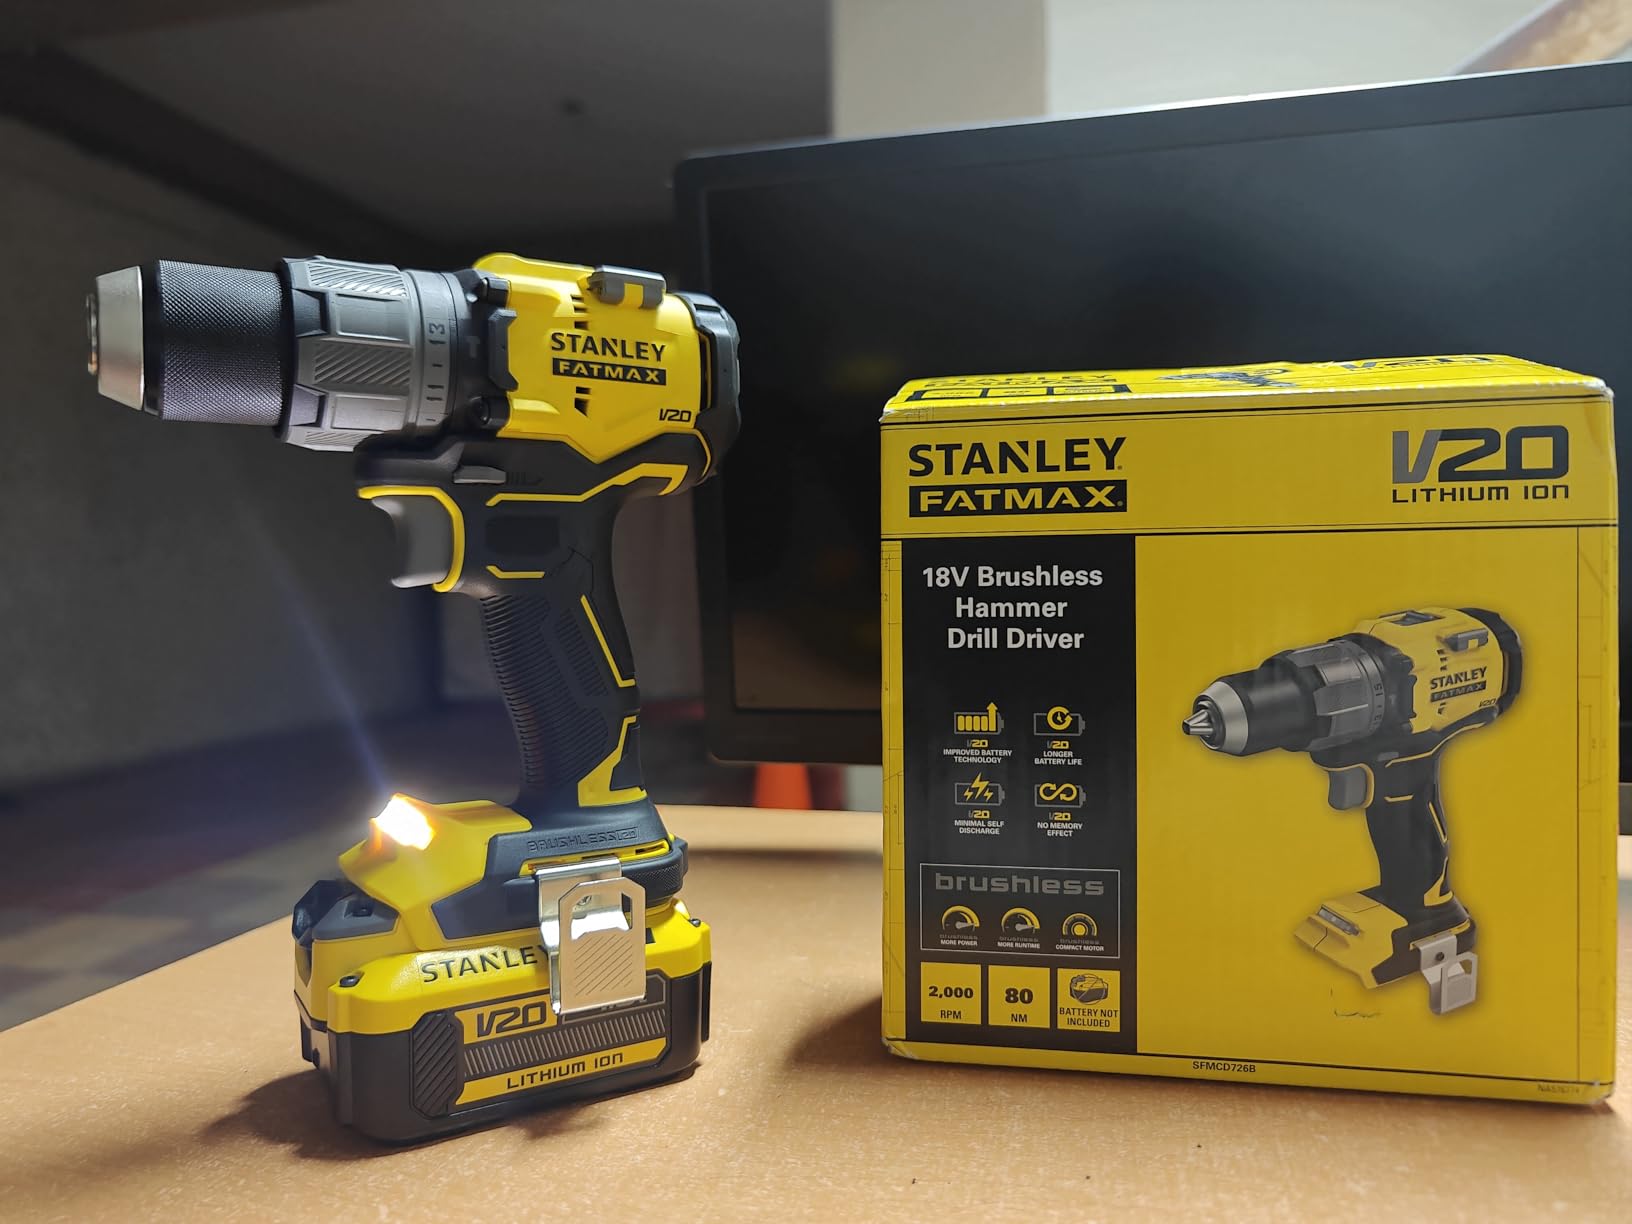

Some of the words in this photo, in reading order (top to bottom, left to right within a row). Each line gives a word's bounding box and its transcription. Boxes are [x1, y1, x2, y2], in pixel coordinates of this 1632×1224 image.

[551, 332, 666, 362] STANLEY
[558, 360, 660, 383] FATMAX
[658, 408, 692, 423] V20
[908, 437, 1126, 477] STANLEY
[1392, 425, 1569, 484] V20
[919, 485, 1117, 512] FATMAX
[1392, 486, 1509, 503] LITHIUM
[922, 566, 970, 588] 18V
[977, 565, 1104, 587] Brushless
[956, 597, 1068, 618] Hammer
[947, 627, 998, 649] Drill
[1006, 627, 1085, 649] Driver
[1430, 666, 1487, 690] STANLEY
[1433, 683, 1483, 699] FATMAX
[954, 756, 1002, 764] TECHNOLOGY
[1067, 758, 1083, 766] LIFE
[959, 827, 1000, 835] DISCHARGE
[1047, 829, 1073, 837] EFFECT
[1050, 822, 1083, 830] MEMORY
[935, 872, 1105, 896] brushless
[928, 985, 974, 999] 2,000
[1005, 987, 1034, 1004] 80
[476, 1000, 548, 1038] V20
[940, 1009, 962, 1020] RPM
[1010, 1013, 1028, 1023] NM
[1059, 1006, 1099, 1018] BATTERY
[1100, 1008, 1119, 1018] NOT
[1066, 1017, 1111, 1028] INCLUDED
[506, 1059, 586, 1090] LITHIUM
[1192, 1061, 1256, 1073] SFMCD726B
